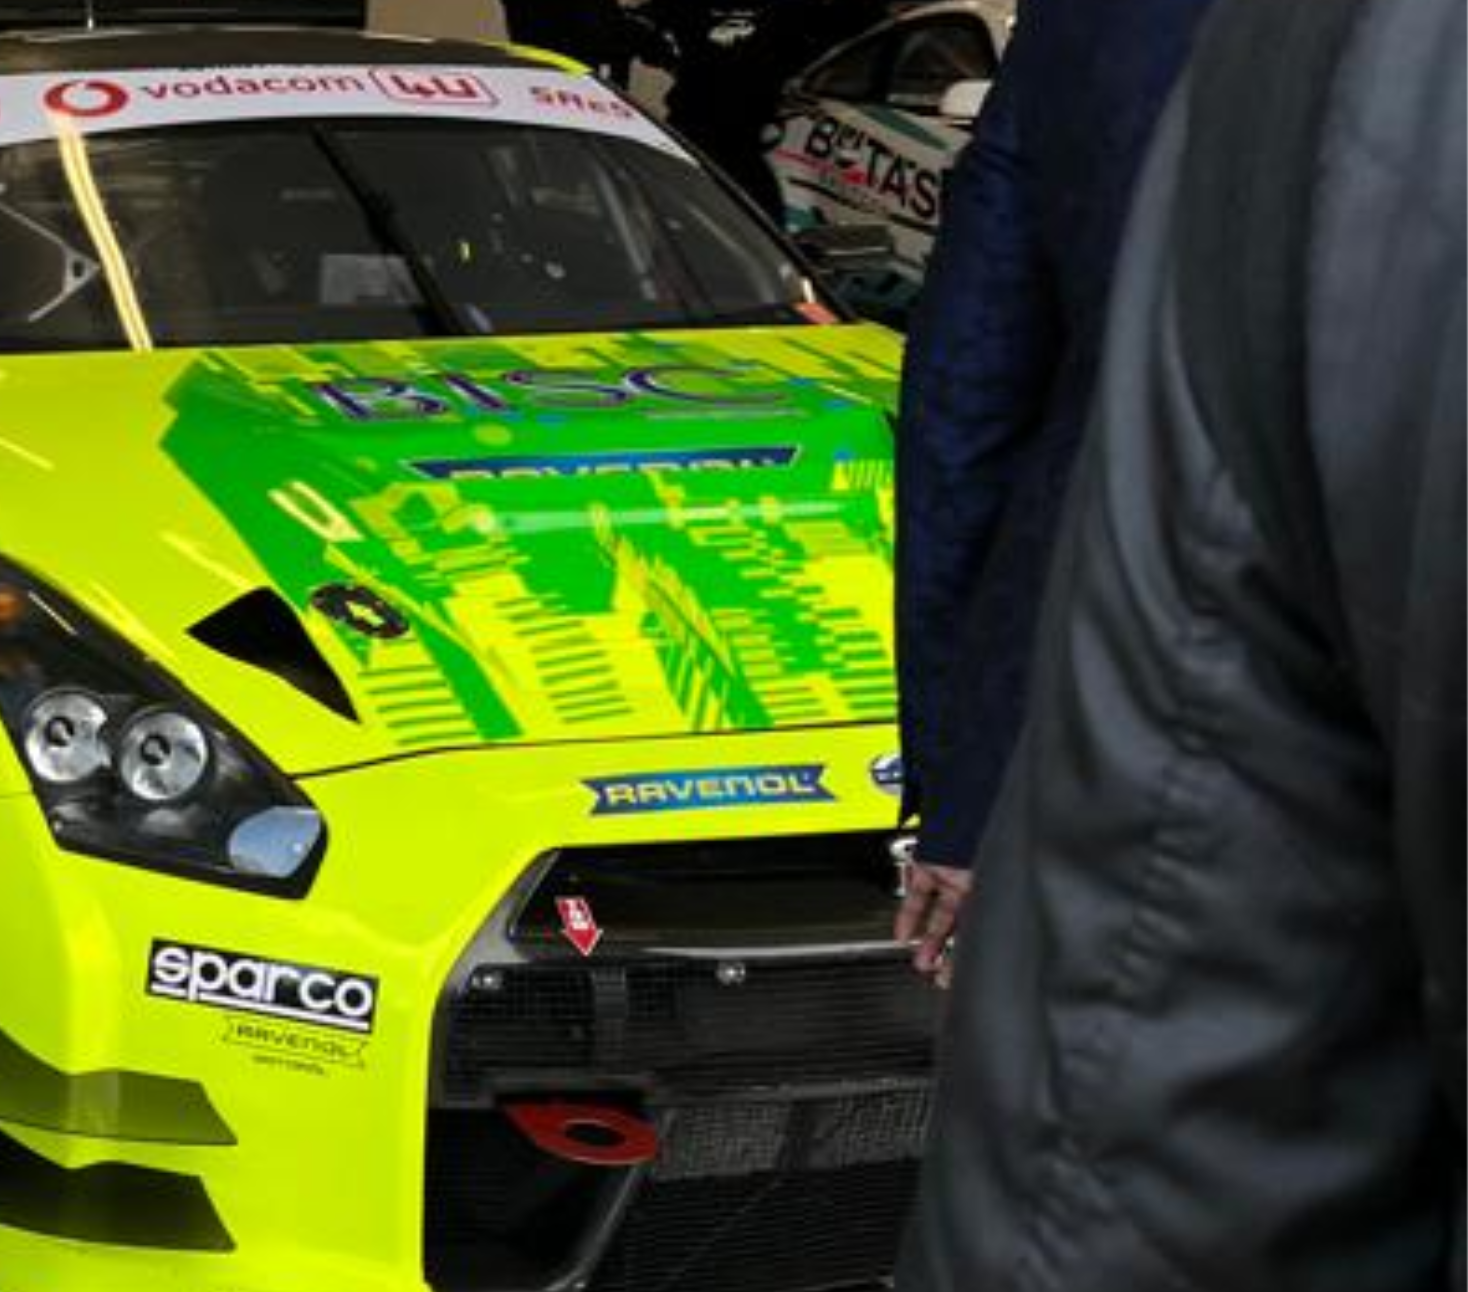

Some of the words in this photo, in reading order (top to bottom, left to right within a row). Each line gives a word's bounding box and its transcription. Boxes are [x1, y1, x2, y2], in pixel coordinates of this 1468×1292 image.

[141, 71, 365, 100] vodacom
[604, 771, 816, 805] RAVENOL
[152, 946, 374, 1018] sparco
